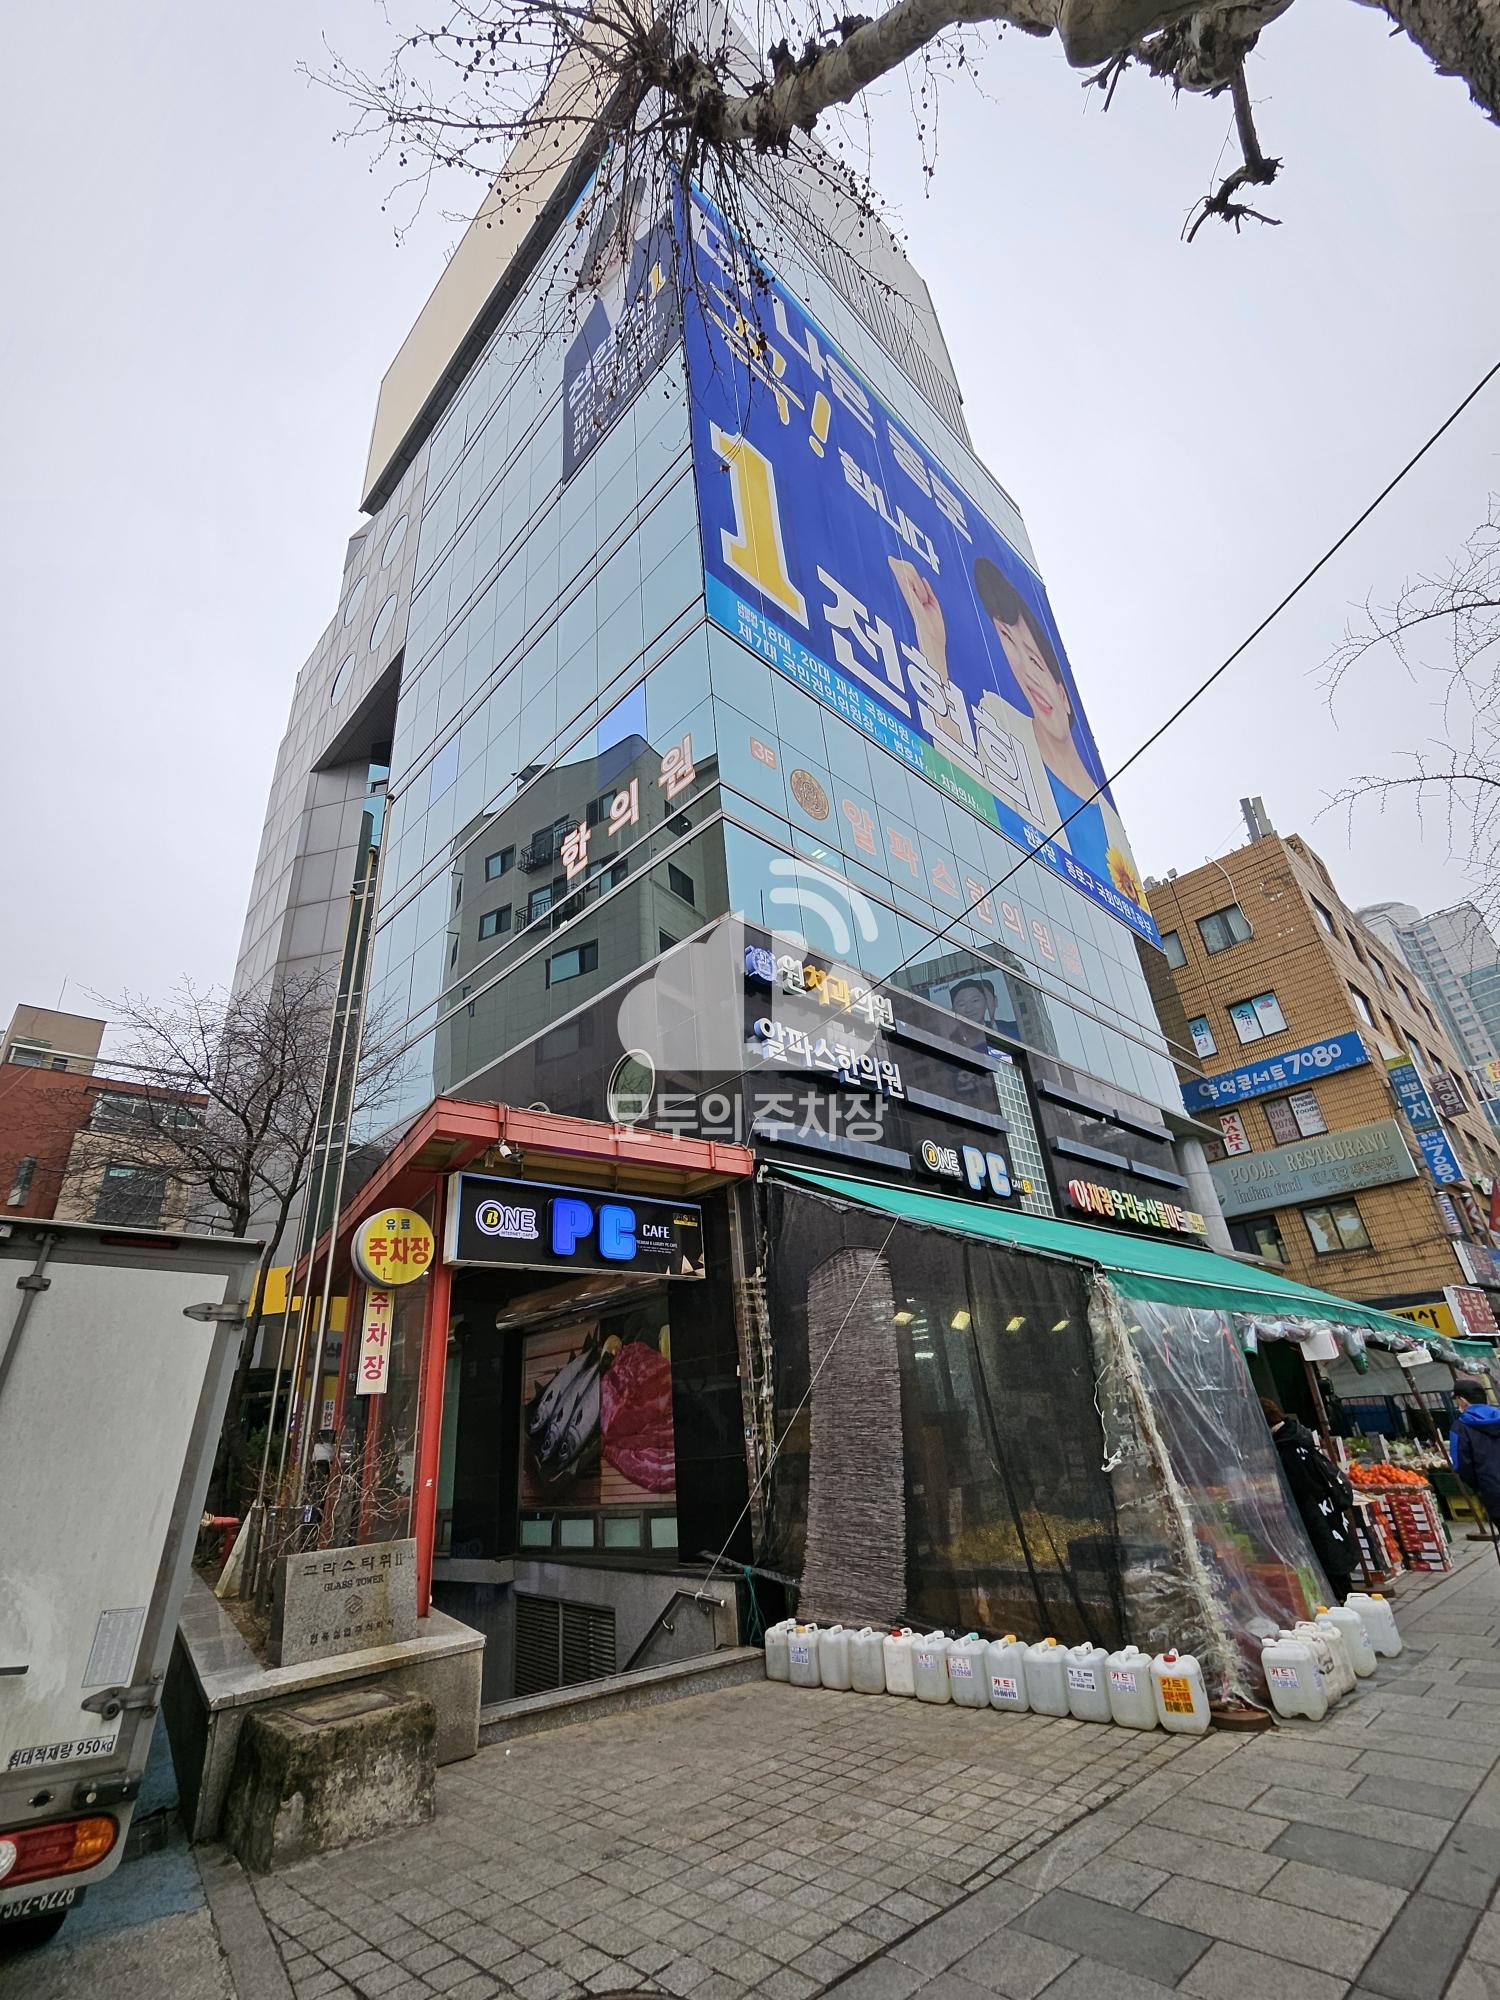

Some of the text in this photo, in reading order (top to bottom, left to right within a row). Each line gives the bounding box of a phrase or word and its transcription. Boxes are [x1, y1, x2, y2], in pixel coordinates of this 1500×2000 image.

[772, 294, 877, 439] 나은
[887, 420, 973, 545] 종로
[709, 418, 810, 631] 1
[838, 446, 941, 575] 합니다
[737, 619, 778, 663] 제7대
[800, 650, 830, 684] 20대
[835, 676, 860, 707] 재선
[816, 565, 1045, 829] 전현희
[752, 740, 775, 765] 3F
[560, 733, 697, 881] 한의원
[1064, 857, 1095, 892] 종로구
[776, 954, 897, 1033] 원치과의원
[753, 1017, 905, 1100] 알파스한의원
[1284, 1042, 1343, 1075] 7080
[1220, 1115, 1244, 1152] MART
[1228, 1159, 1281, 1187] POOJA
[1284, 1130, 1391, 1173] RESTAURANT
[961, 1144, 1012, 1197] PC
[1425, 1144, 1456, 1183] 7080
[1233, 1178, 1303, 1205] Indian food
[368, 1235, 432, 1266] 주차장
[385, 1217, 411, 1231] 유료
[552, 1197, 638, 1262] PC
[642, 1223, 671, 1239] CAFE
[363, 1291, 390, 1381] 주차장
[323, 1574, 385, 1592] GLASS TOWER
